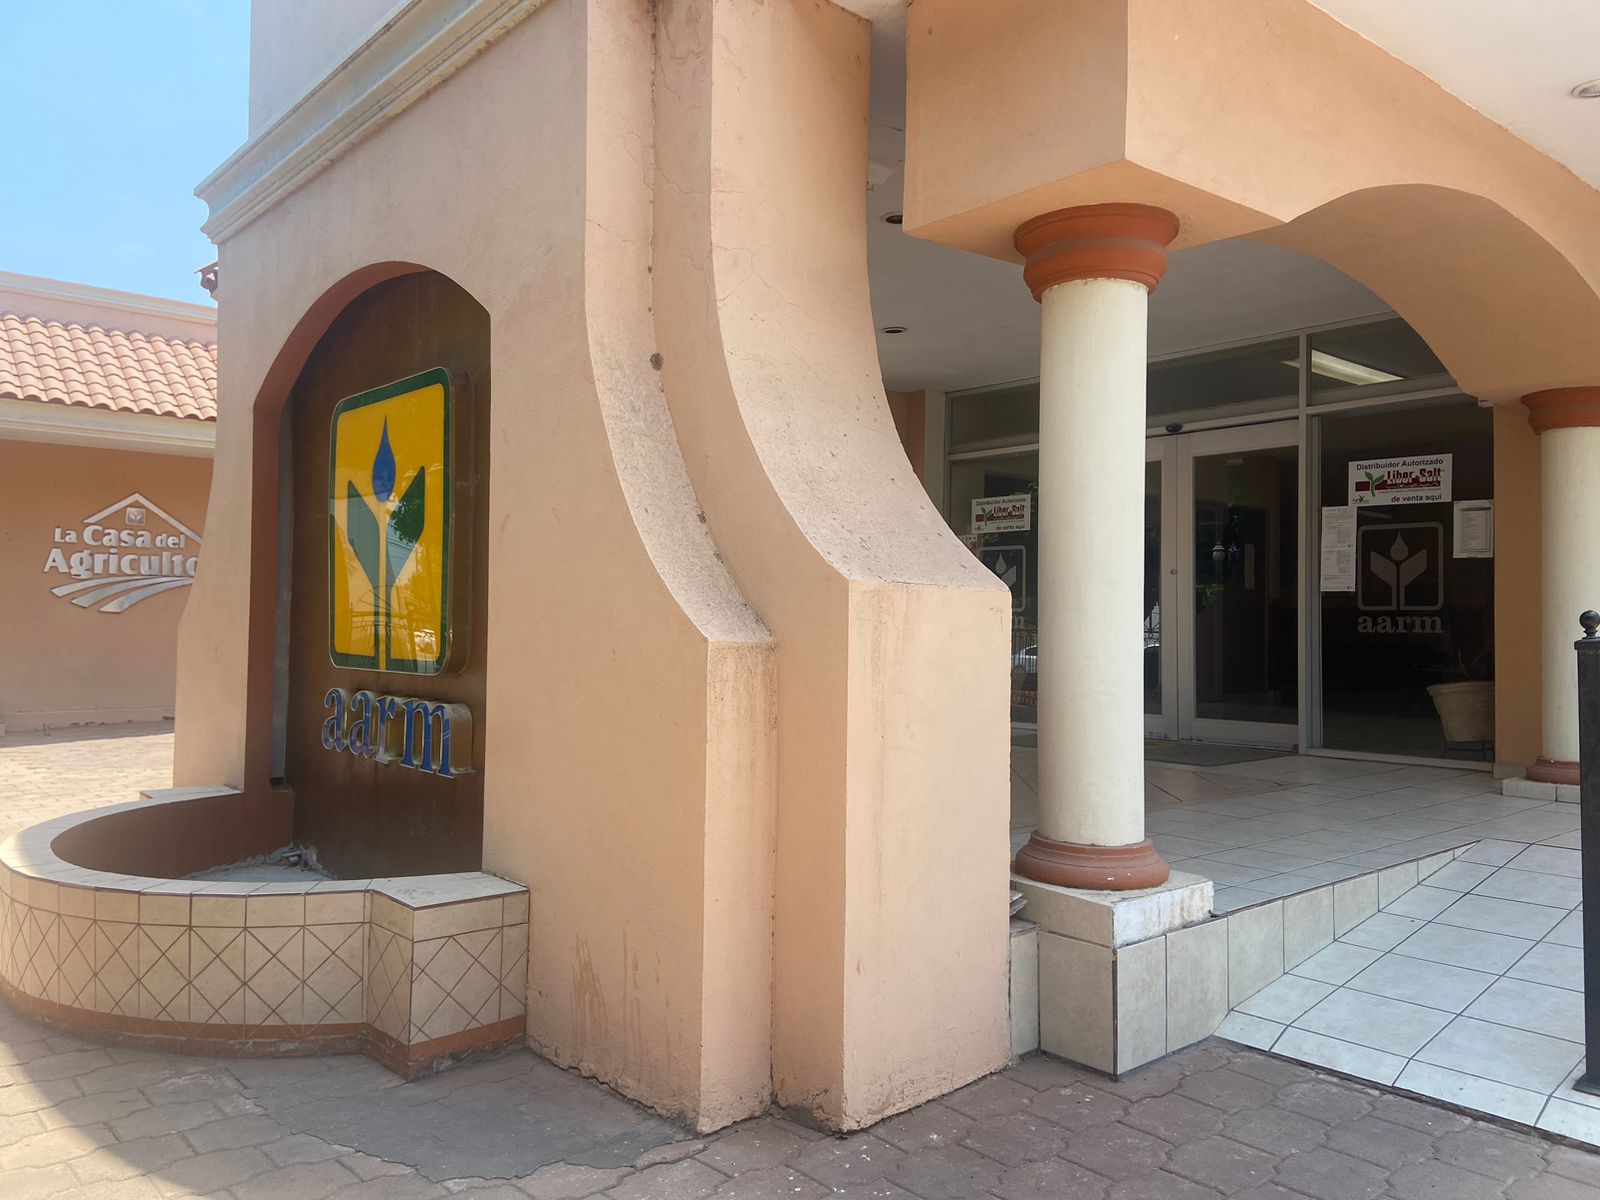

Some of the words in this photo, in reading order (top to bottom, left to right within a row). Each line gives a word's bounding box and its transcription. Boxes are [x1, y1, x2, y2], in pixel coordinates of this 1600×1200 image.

[1356, 462, 1400, 471] Distribuidor
[1401, 458, 1444, 468] Autorizado
[54, 527, 78, 543] La
[83, 525, 152, 548] Casa
[155, 533, 186, 549] del
[1357, 615, 1444, 634] aarm
[321, 687, 457, 779] aarm
